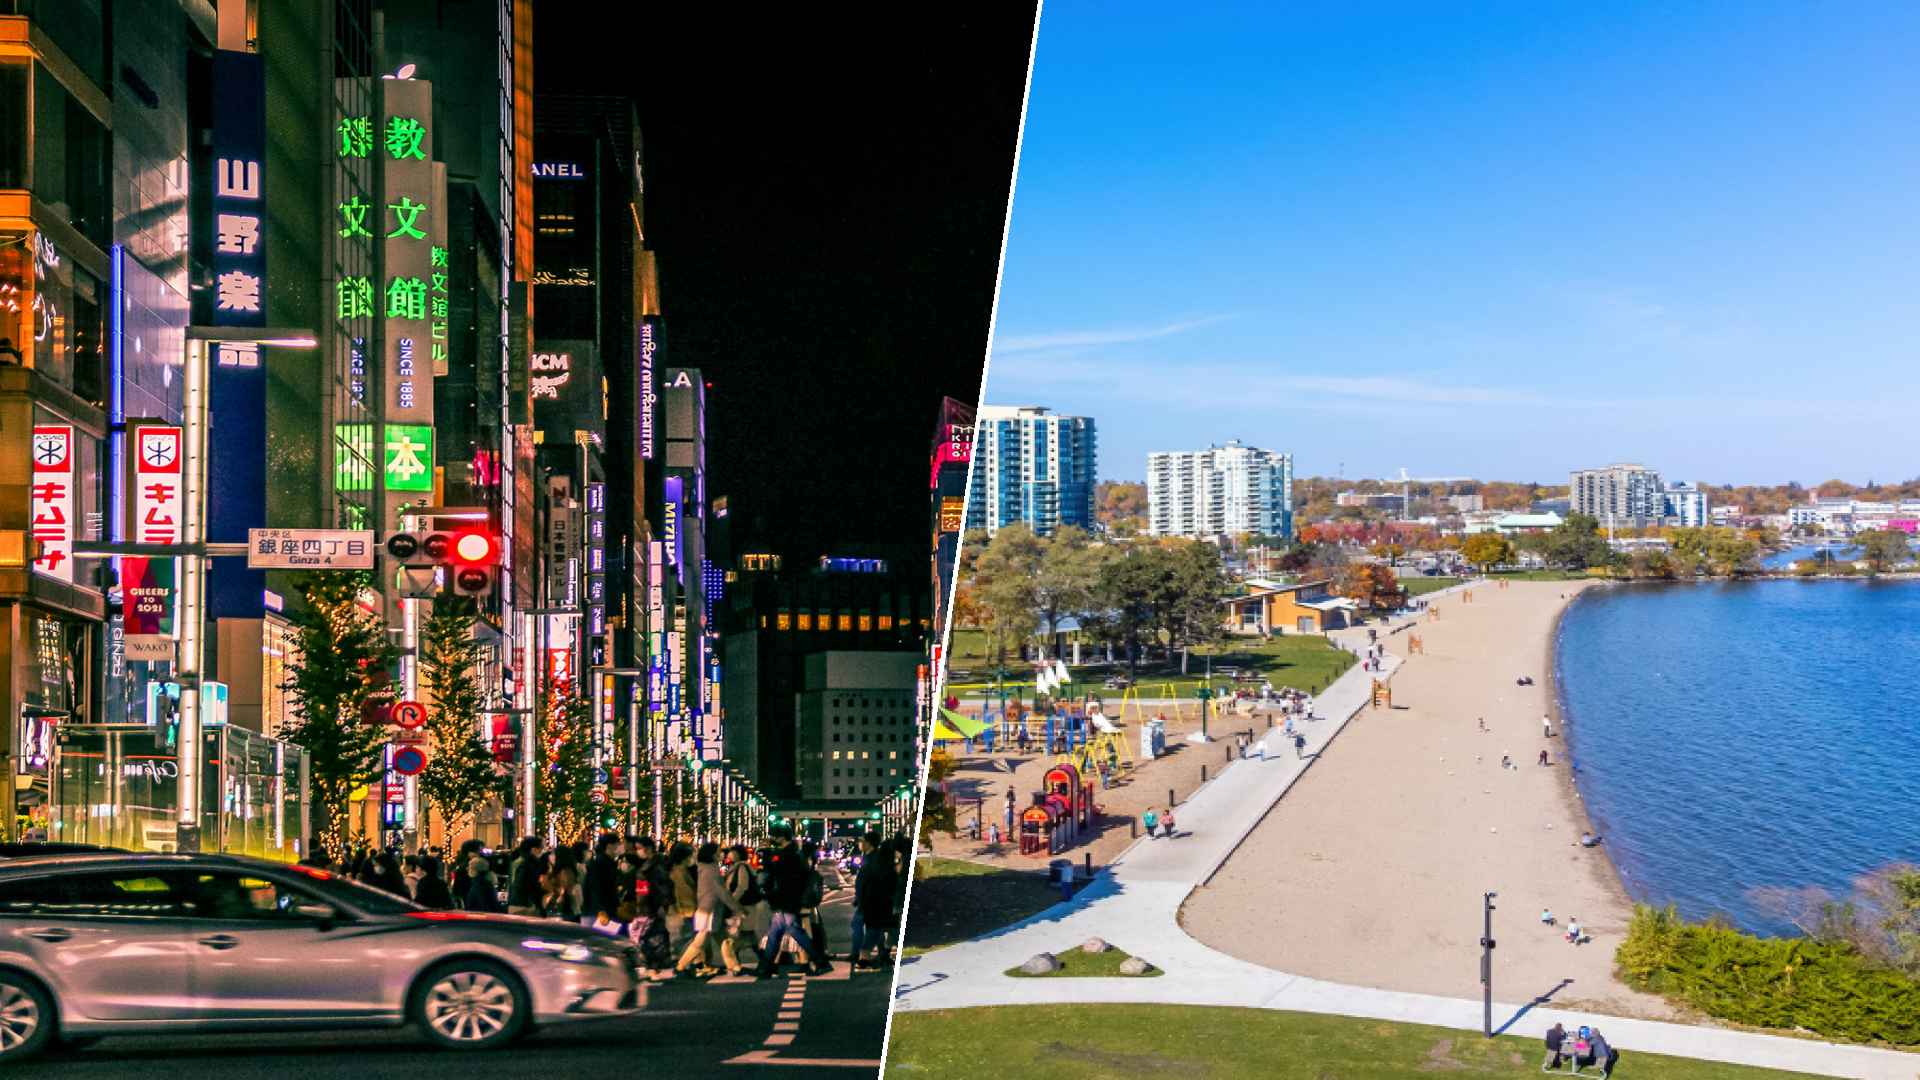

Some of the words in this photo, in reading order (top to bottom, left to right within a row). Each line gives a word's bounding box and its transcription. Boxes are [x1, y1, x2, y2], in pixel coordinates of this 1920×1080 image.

[384, 116, 427, 320] 教文館
[399, 338, 414, 376] SINCE
[399, 381, 414, 409] 1885
[387, 436, 426, 480] 本
[257, 530, 291, 538] 中央区
[257, 539, 365, 556] 銀座四丁目
[288, 555, 320, 564] Ginza
[324, 556, 332, 564] 4
[130, 588, 169, 596] CHEERS
[137, 604, 162, 612] 2021
[134, 643, 169, 652] WAKO
